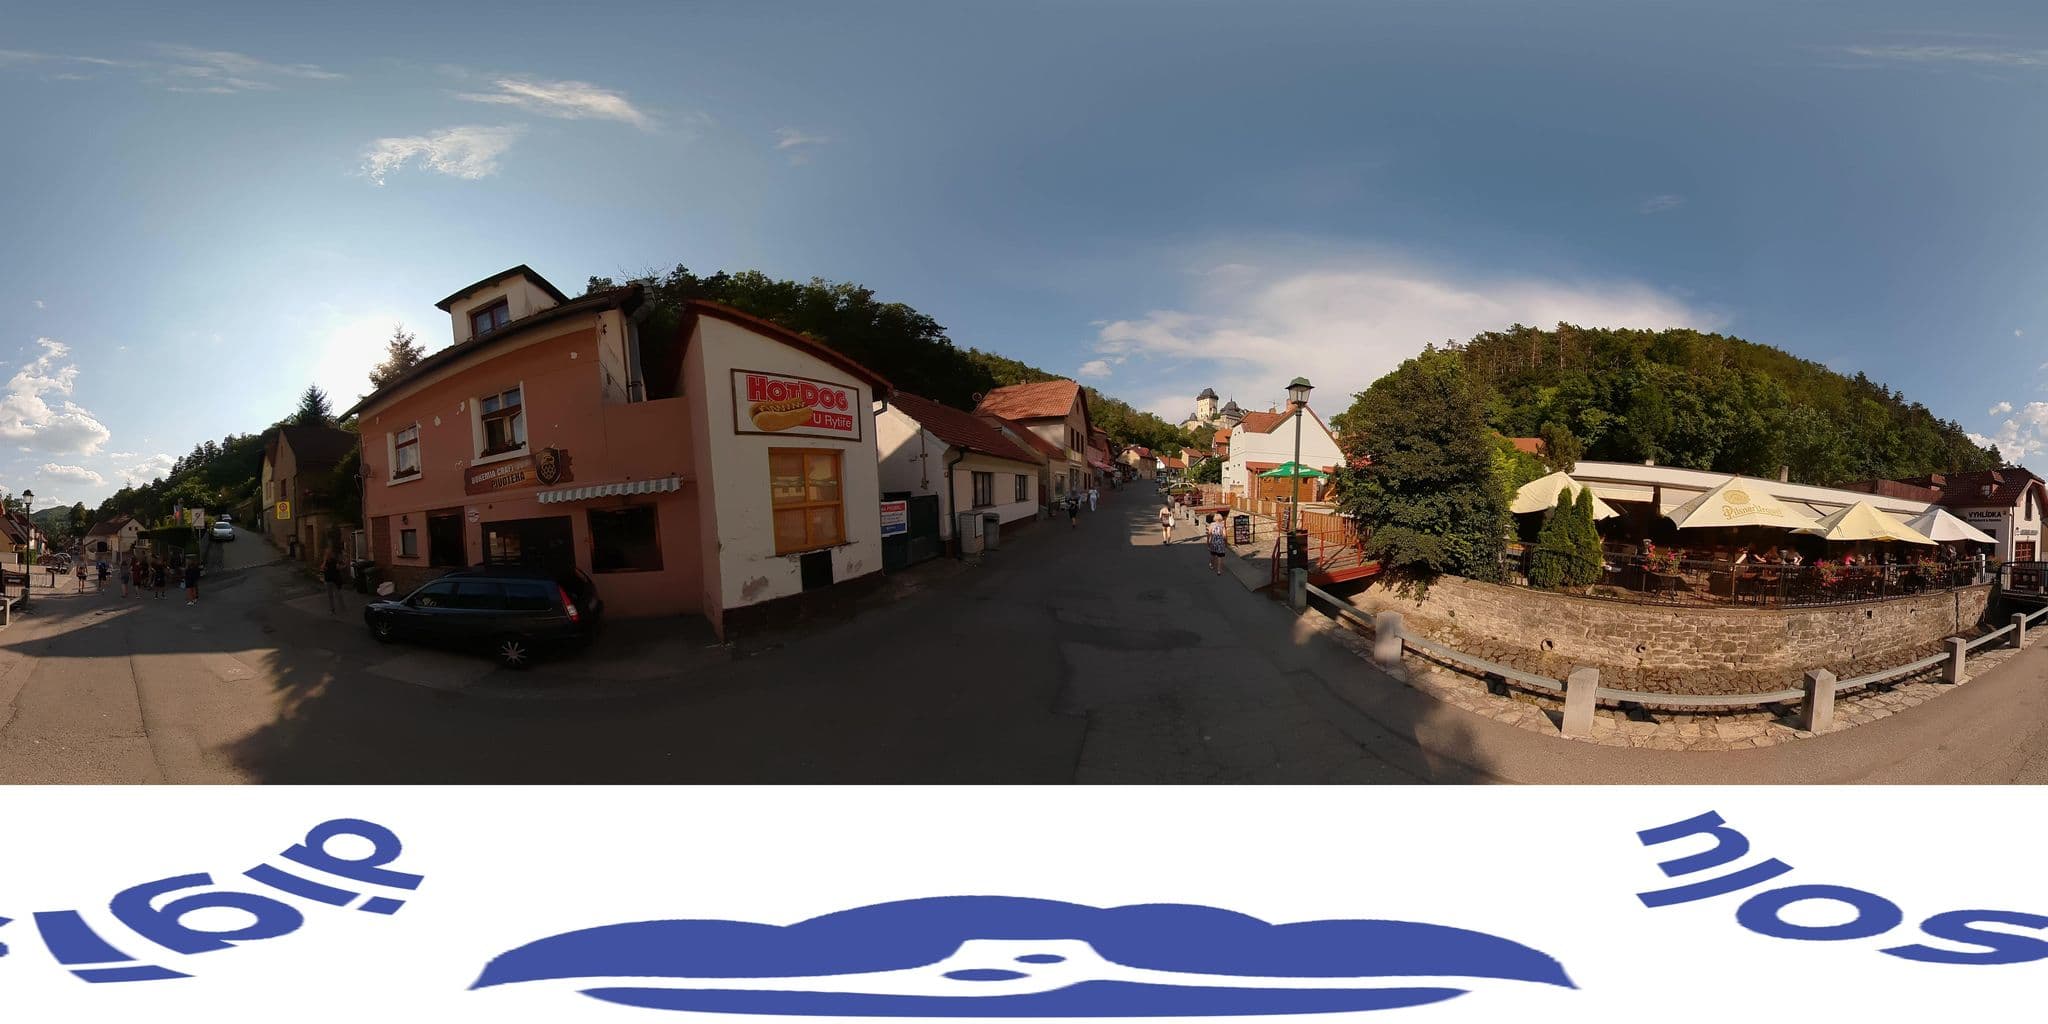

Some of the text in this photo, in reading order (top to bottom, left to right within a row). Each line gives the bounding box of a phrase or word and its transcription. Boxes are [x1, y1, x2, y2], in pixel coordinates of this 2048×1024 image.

[813, 414, 822, 424] U
[491, 471, 526, 488] PIVOTEKA
[1968, 510, 2002, 518] VYHLÍDKA
